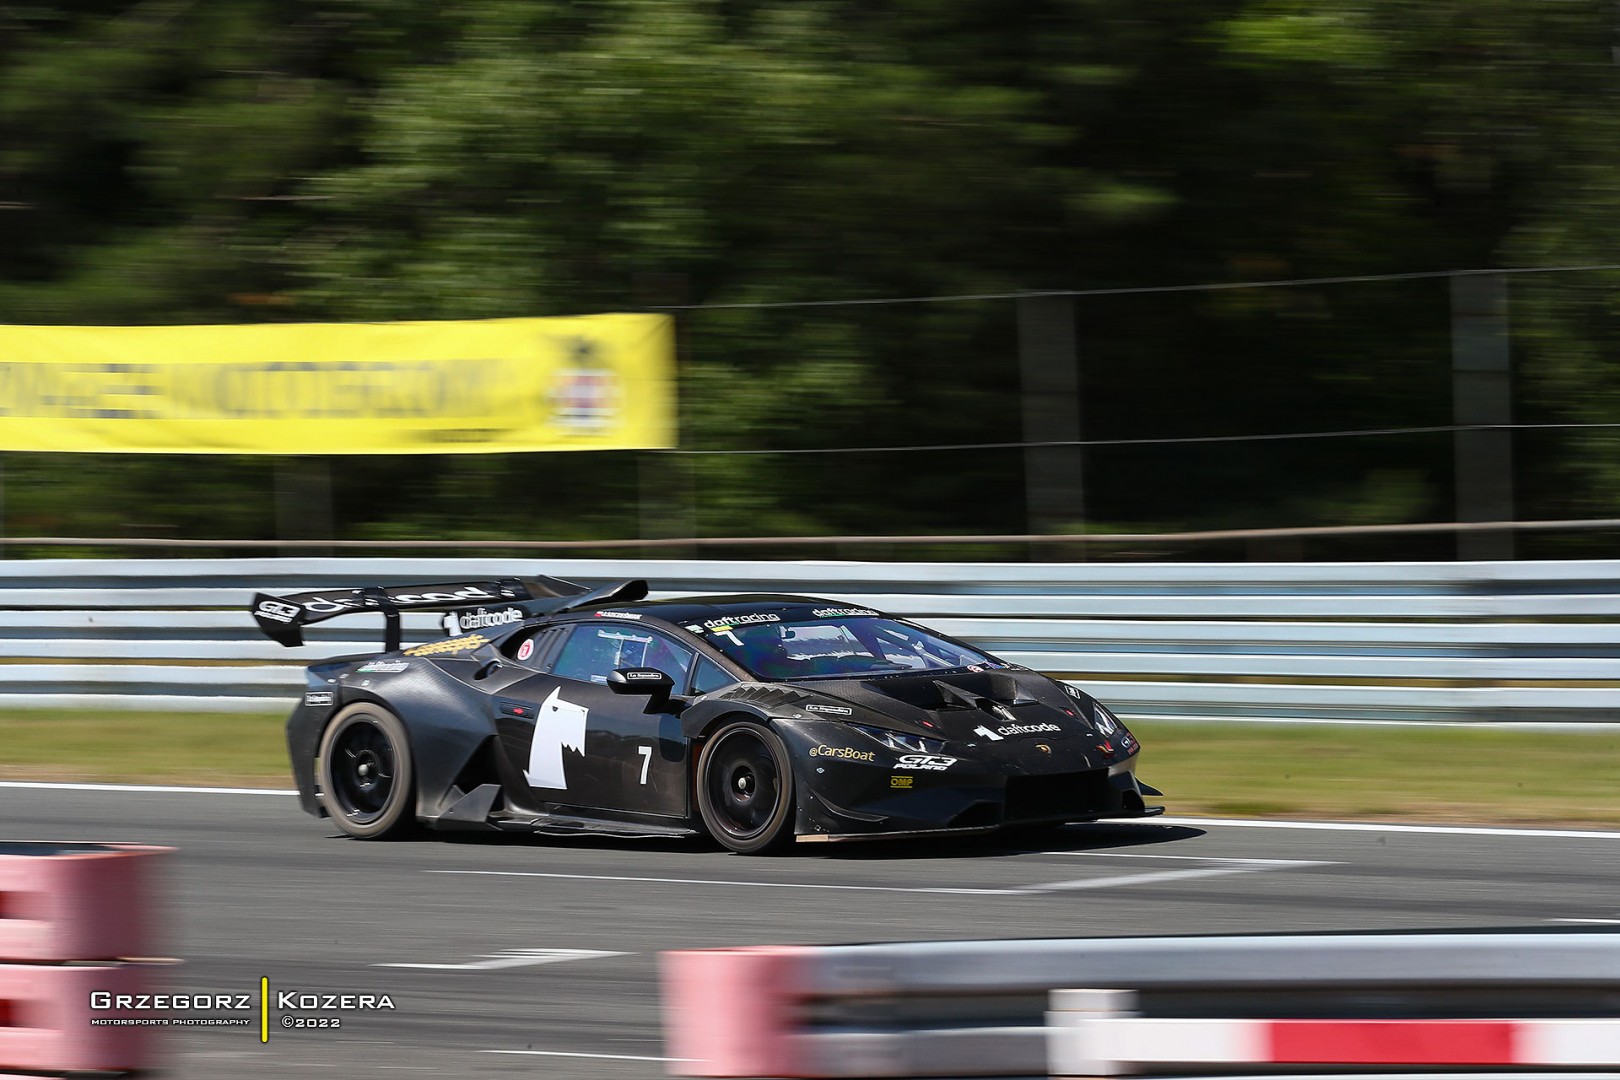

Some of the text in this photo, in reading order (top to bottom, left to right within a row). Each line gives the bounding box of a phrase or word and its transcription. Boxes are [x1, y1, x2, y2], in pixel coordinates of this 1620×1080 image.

[302, 587, 515, 613] dacod
[460, 607, 523, 630] daftcode
[704, 612, 781, 629] daftracing
[713, 630, 744, 647] 7
[997, 722, 1062, 736] daftcode
[809, 744, 876, 762] @CarsBoat
[898, 754, 958, 767] GT3
[638, 746, 652, 785] 7
[893, 763, 949, 771] POLAND
[890, 778, 914, 786] OMP
